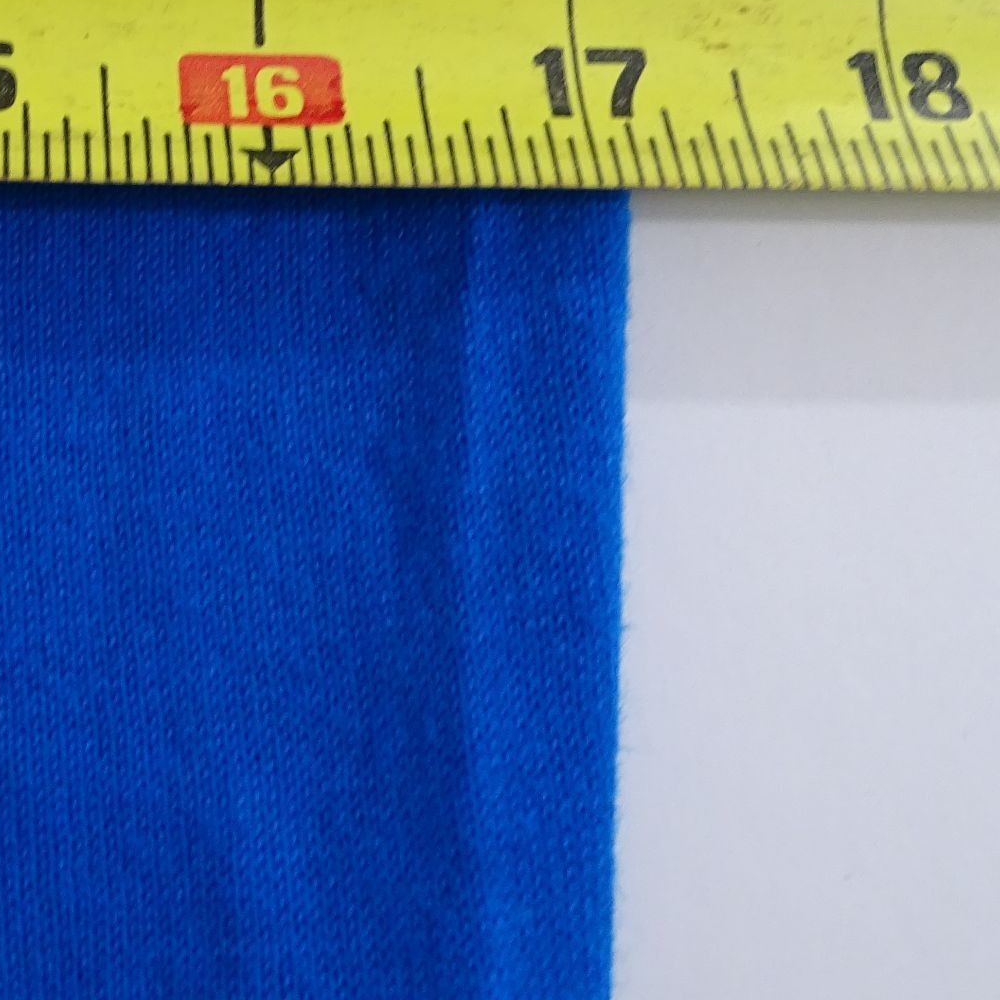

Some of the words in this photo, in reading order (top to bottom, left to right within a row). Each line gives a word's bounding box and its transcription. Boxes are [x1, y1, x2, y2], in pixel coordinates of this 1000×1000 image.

[221, 65, 305, 119] 16
[533, 47, 647, 118] 17
[847, 50, 973, 121] 18
